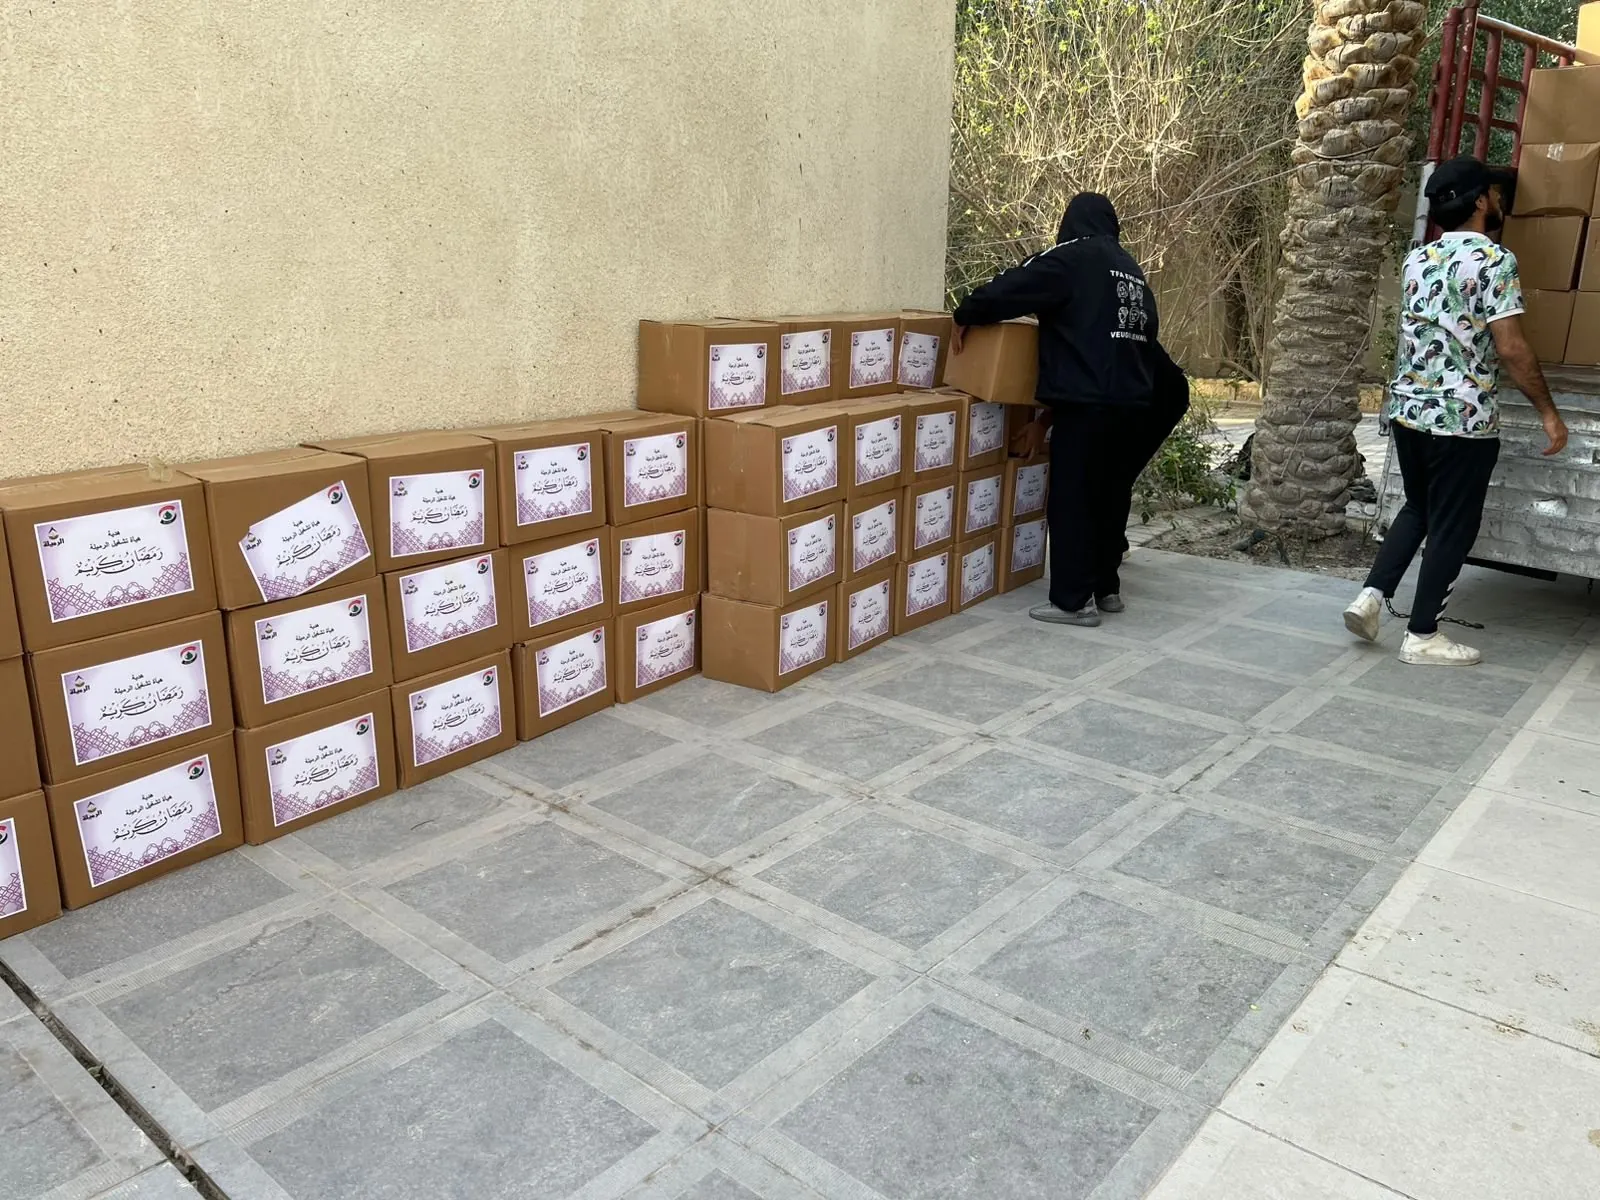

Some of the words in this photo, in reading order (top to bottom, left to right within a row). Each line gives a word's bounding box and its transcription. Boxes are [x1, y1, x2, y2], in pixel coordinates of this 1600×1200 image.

[292, 519, 303, 527] هدية
[107, 529, 120, 537] هدية
[297, 523, 311, 536] تشغيل
[281, 531, 297, 542] الرميلة
[89, 541, 110, 551] الرميلة
[110, 537, 129, 548] تشغيل
[294, 632, 311, 641] الرميلة
[311, 629, 325, 638] تشغيل
[131, 673, 144, 681] هدية
[113, 684, 133, 694] الرميلة
[134, 679, 152, 690] تشغيل
[304, 754, 320, 764] الرميلة
[320, 749, 334, 760] تشغيل
[141, 792, 153, 800] هدية
[144, 797, 161, 810] تشغيل
[124, 804, 144, 815] الرميلة
